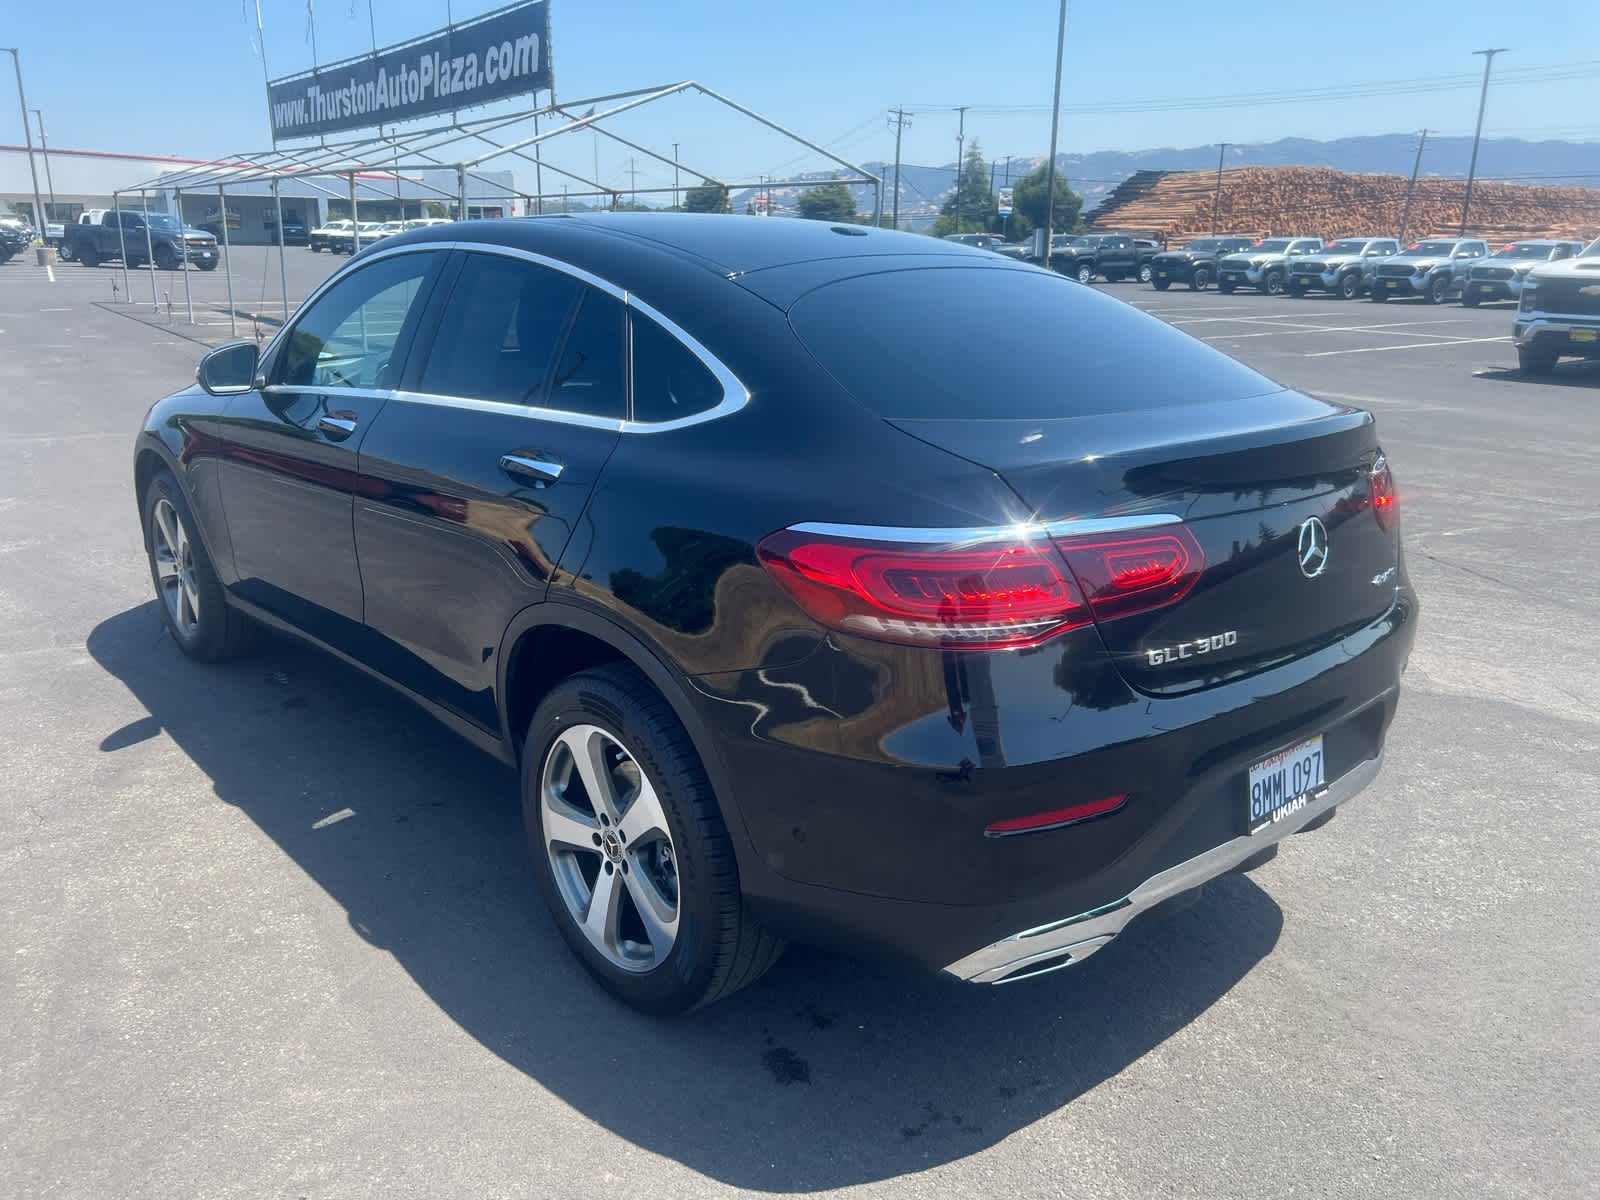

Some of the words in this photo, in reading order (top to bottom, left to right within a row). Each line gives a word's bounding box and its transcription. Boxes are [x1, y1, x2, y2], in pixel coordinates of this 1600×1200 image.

[273, 32, 540, 129] www.ThurstonAutoPlaza.com
[1147, 642, 1193, 666] GLC
[1197, 630, 1237, 654] 300
[1251, 751, 1321, 817] 8MML097
[1272, 793, 1307, 823] UKIAH
